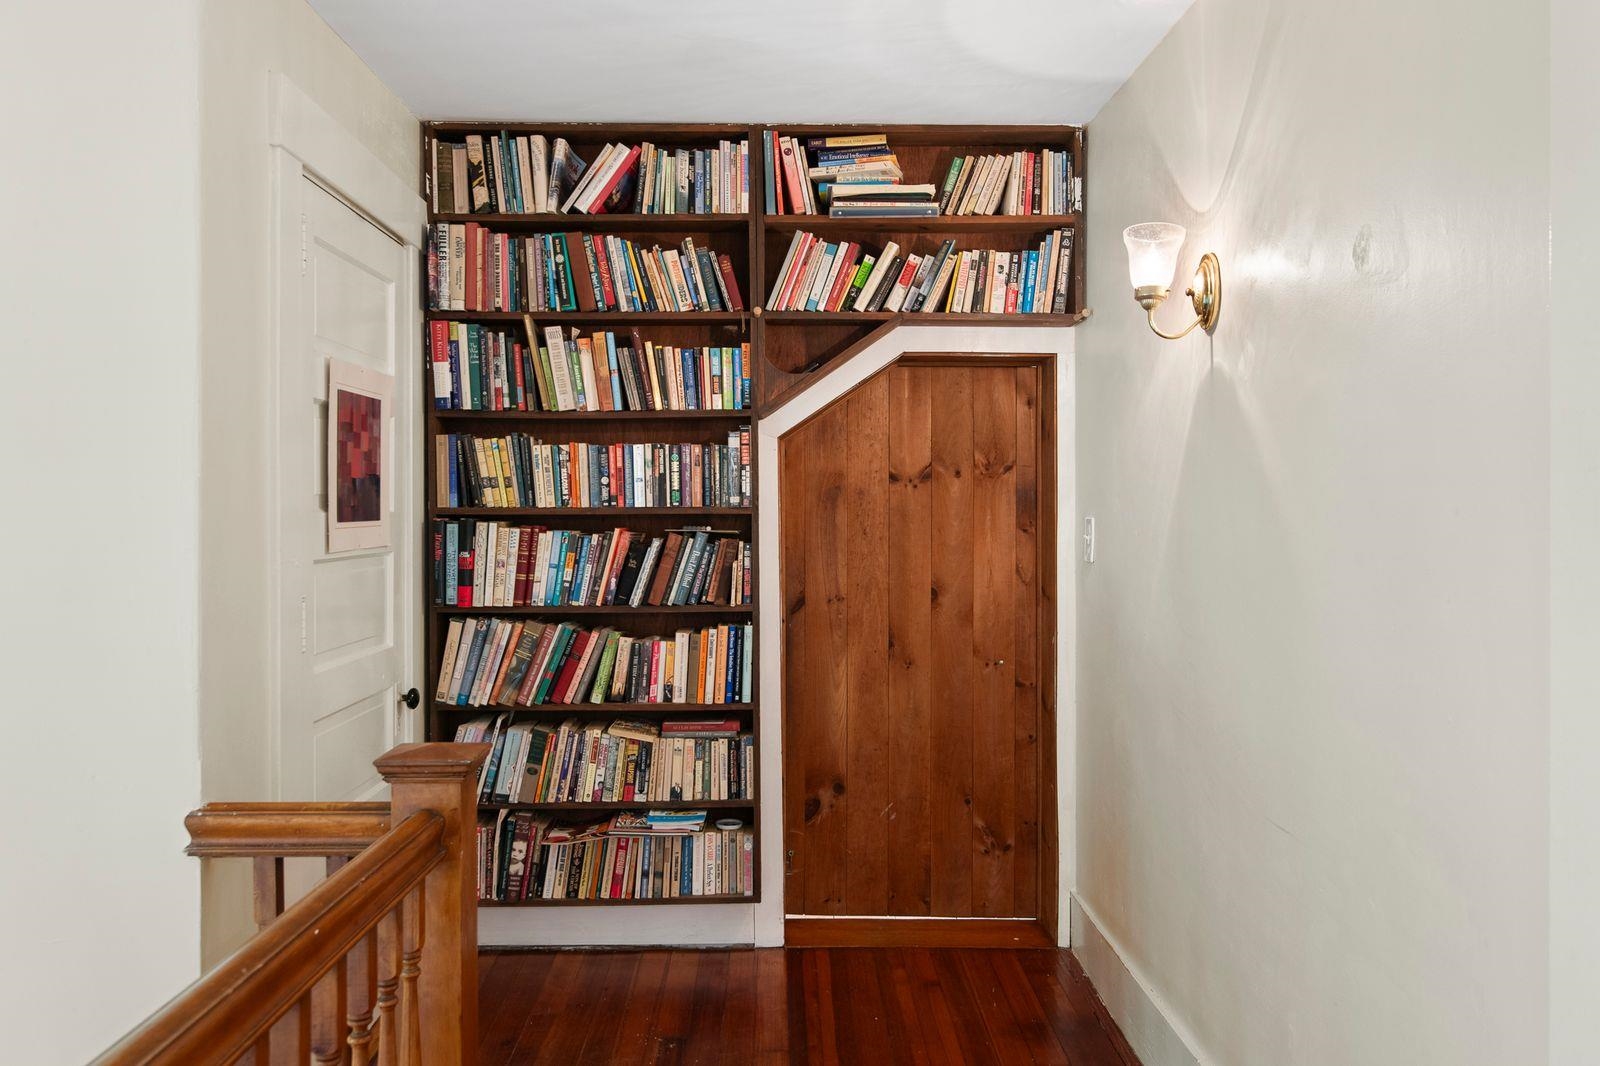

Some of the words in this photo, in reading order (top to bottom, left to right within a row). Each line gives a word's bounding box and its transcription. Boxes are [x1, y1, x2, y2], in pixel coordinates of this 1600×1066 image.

[439, 230, 447, 261] FULLER
[436, 341, 445, 361] KELLEY
[573, 364, 583, 390] Australia
[561, 468, 569, 495] MALCOLM
[682, 572, 694, 588] Alfred
